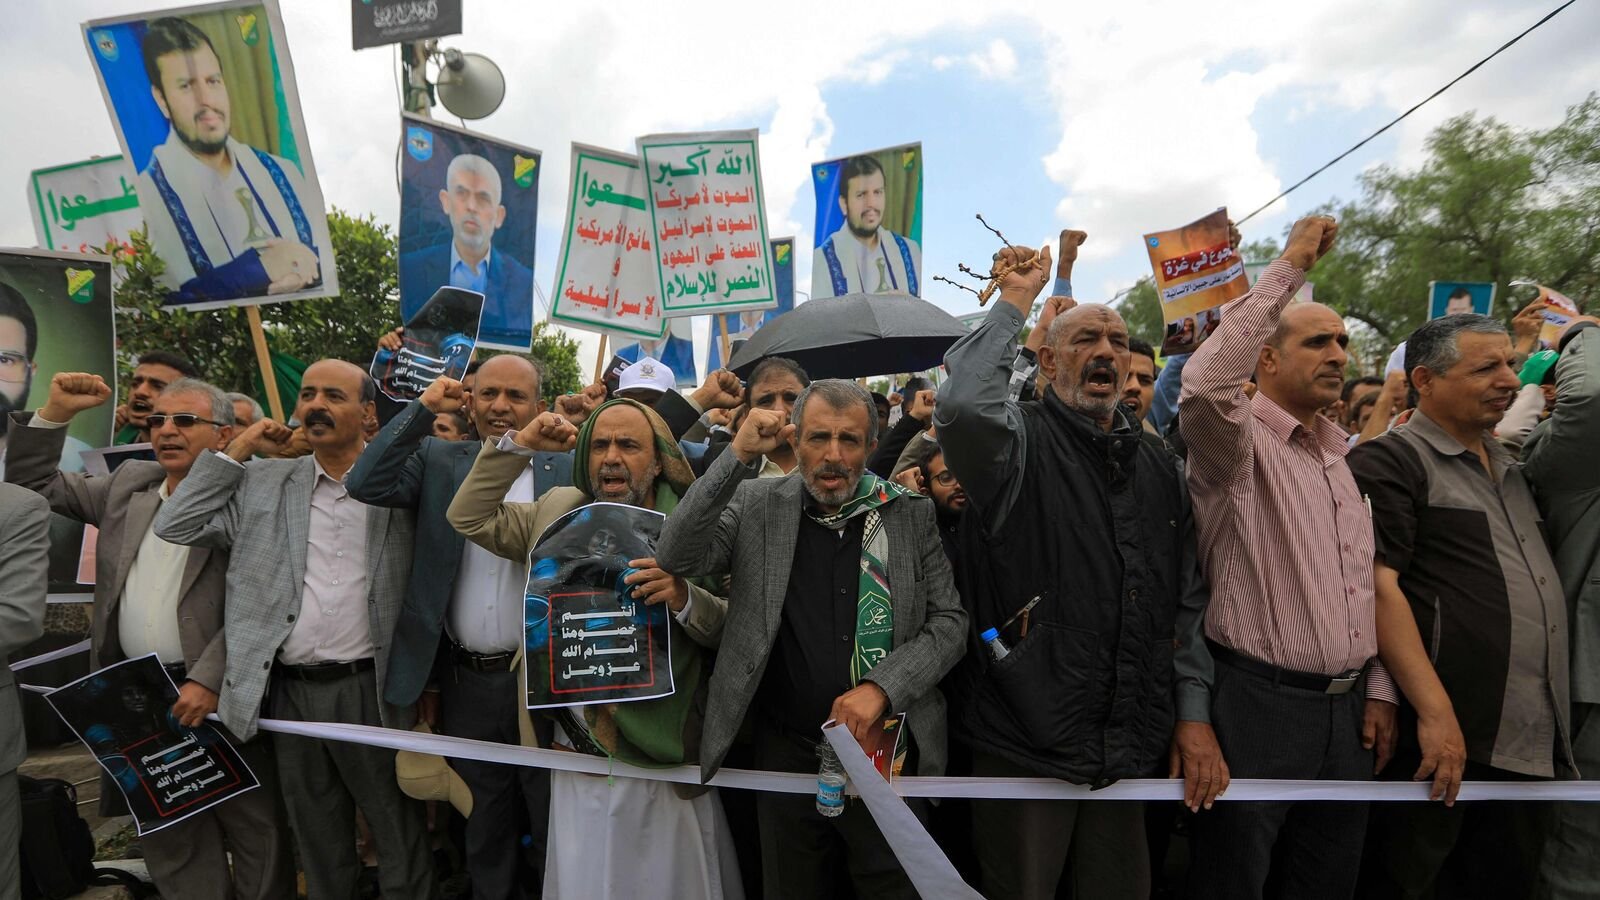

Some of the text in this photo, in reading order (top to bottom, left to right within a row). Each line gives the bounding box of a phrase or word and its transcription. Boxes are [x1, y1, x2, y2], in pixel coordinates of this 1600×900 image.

[653, 145, 751, 186] الله أكبر
[47, 175, 140, 231] طعوا
[655, 182, 754, 210] الموت لأمريكا
[660, 214, 713, 241] لإسرائيل
[717, 214, 758, 235] الموت
[662, 241, 761, 269] اللعنة على اليهود
[1191, 251, 1208, 273] في
[612, 256, 621, 277] و
[1165, 257, 1190, 277] غزة
[666, 264, 766, 303] النصر للإسلام
[562, 602, 636, 624] أنتم
[562, 624, 637, 641] خصومنا
[562, 638, 638, 660] أمام الله
[562, 661, 640, 680] عز وجل
[147, 746, 206, 776] خصومنا
[157, 774, 172, 788] الله
